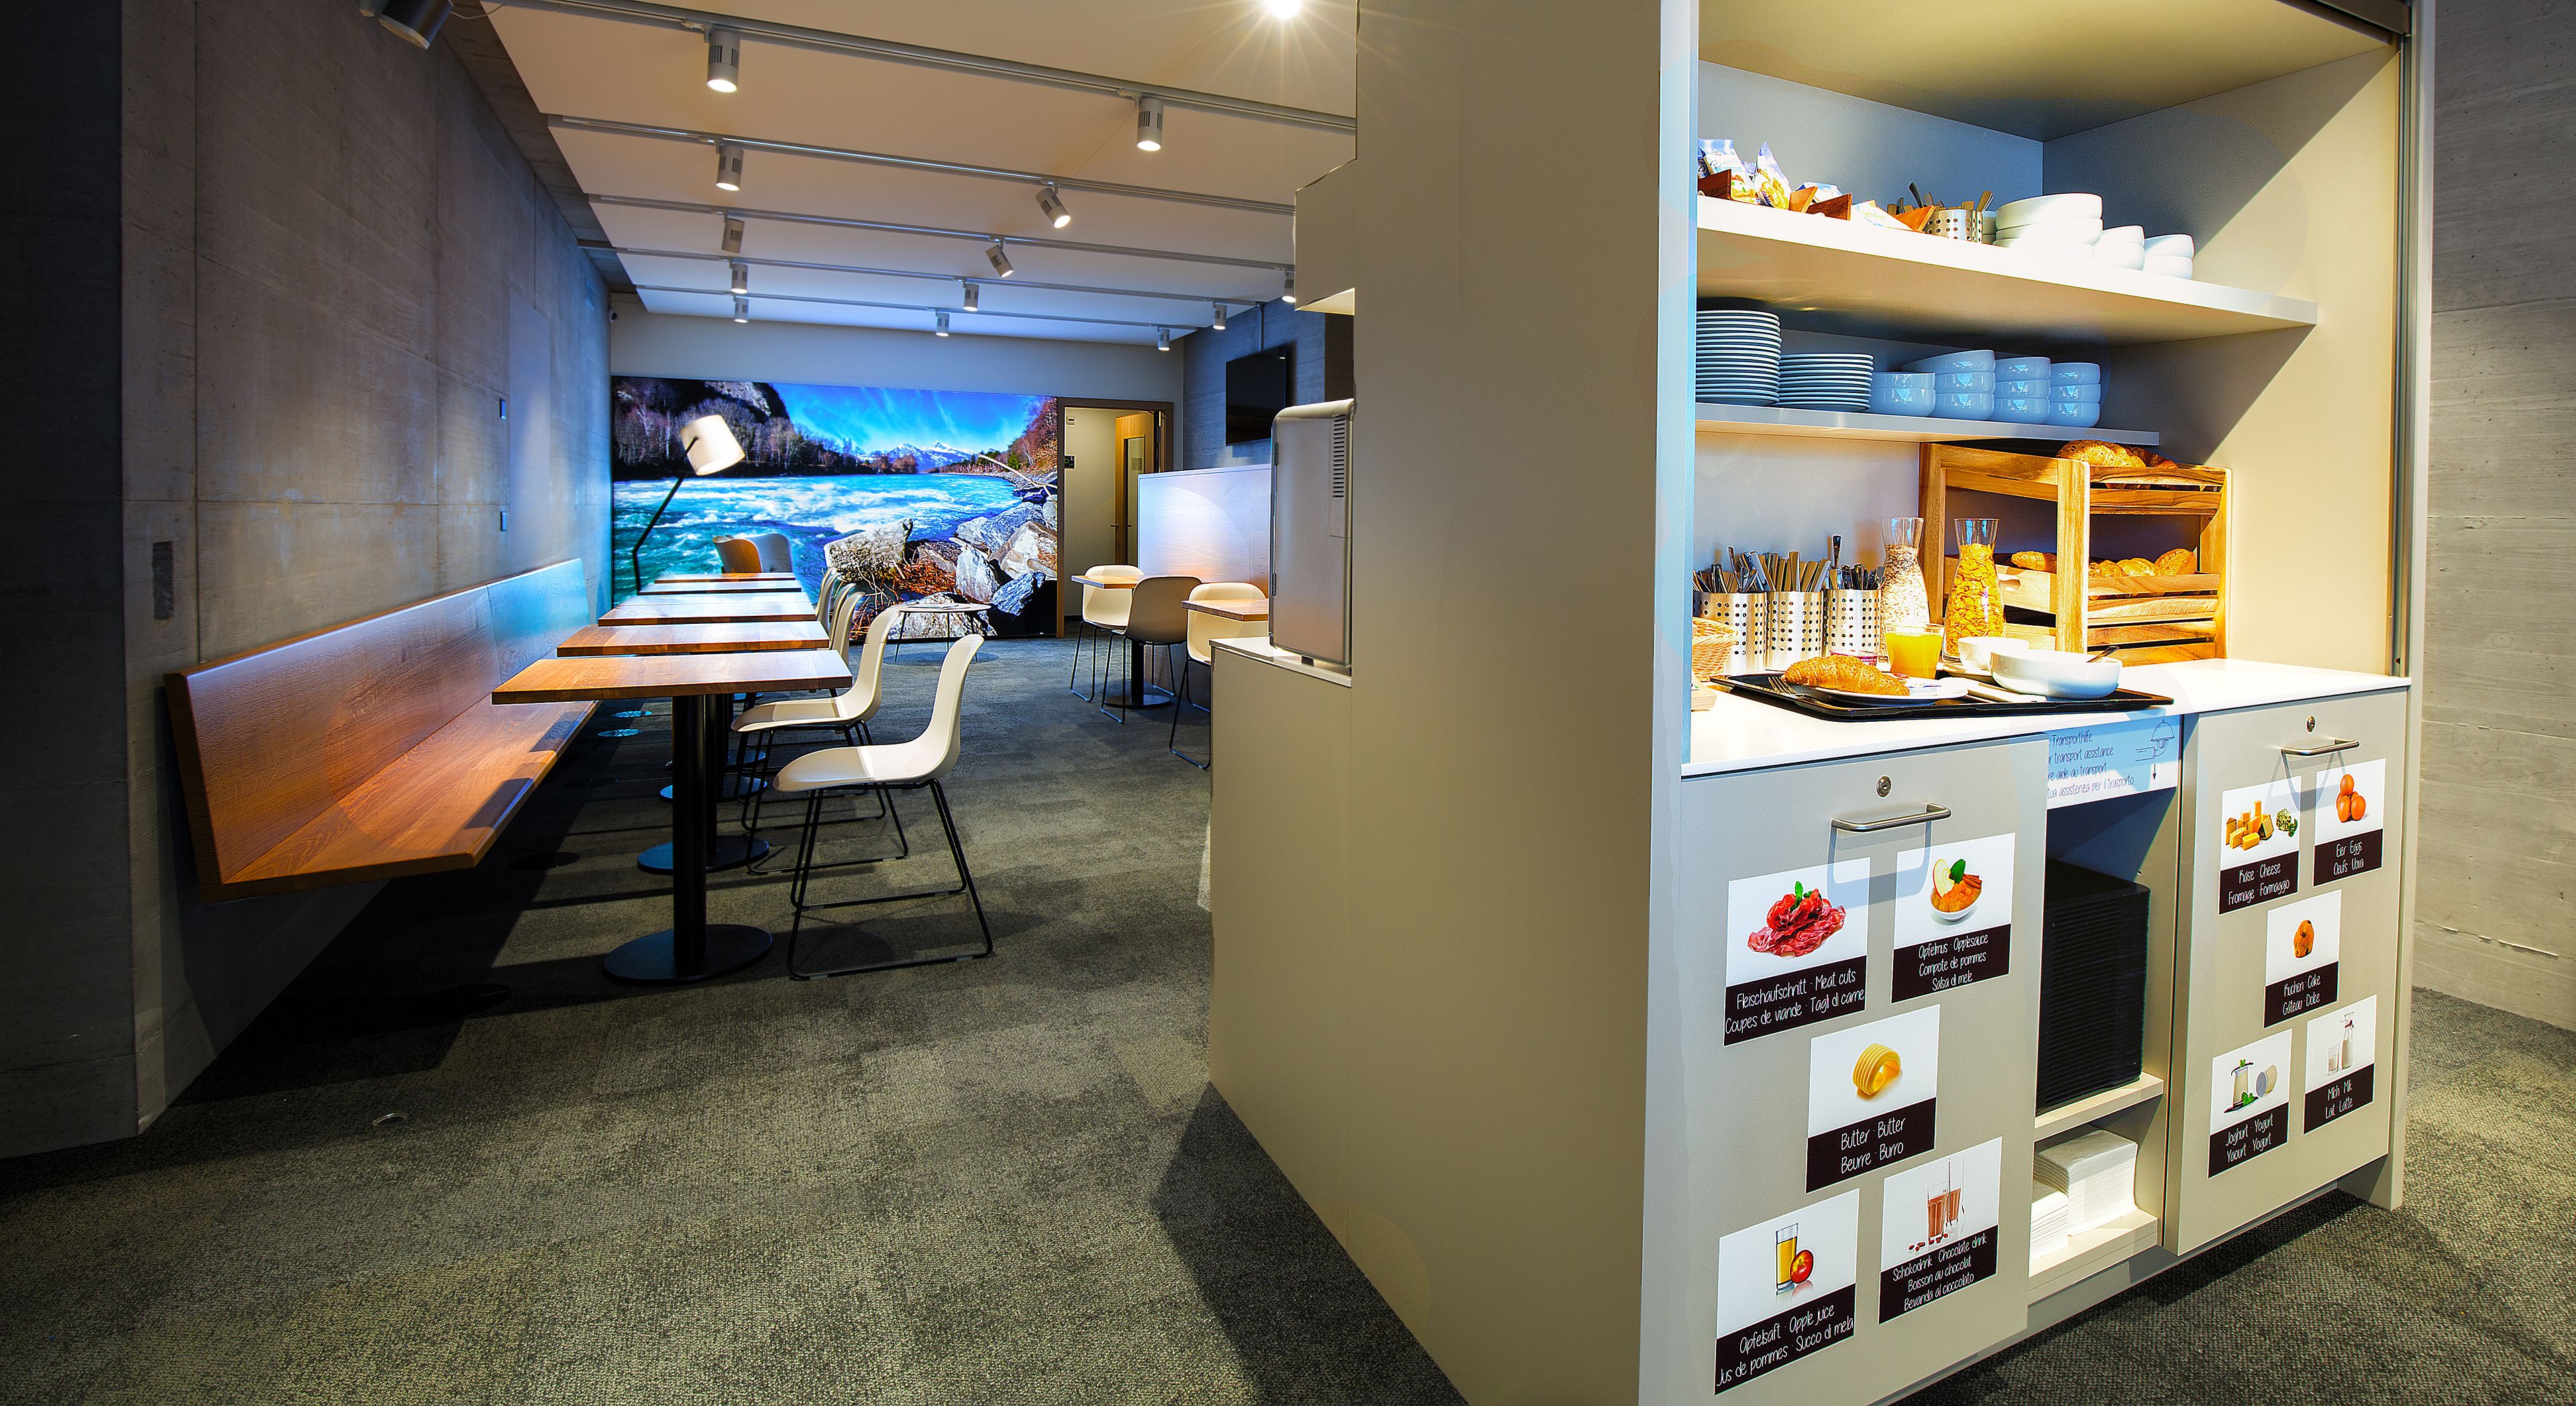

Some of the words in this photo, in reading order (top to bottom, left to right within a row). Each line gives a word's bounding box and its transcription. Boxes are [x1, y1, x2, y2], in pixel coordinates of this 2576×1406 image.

[2054, 749, 2082, 764] transport
[2084, 746, 2113, 759] assistance
[2057, 767, 2069, 780] aide
[2071, 769, 2078, 777] au
[2080, 762, 2106, 777] transport
[2059, 783, 2090, 797] assistenza
[2092, 781, 2100, 794] per
[2108, 774, 2134, 789] trasporto
[2350, 840, 2362, 855] Eggs
[2239, 869, 2254, 883] Käse
[2260, 863, 2281, 878] Cheese
[2334, 859, 2348, 875] Oeufs
[2351, 857, 2364, 870] Uova
[2229, 889, 2255, 906] Fromage
[2260, 877, 2290, 896] Formaggio
[1919, 959, 1948, 977] Compote
[1950, 957, 1958, 969] de
[1960, 953, 1986, 969] pommes
[1737, 979, 1807, 1010] Fleischaufschnitt
[1816, 972, 1836, 991] Meat
[1839, 968, 1856, 984] cuts
[1932, 977, 1949, 991] Salsa
[1951, 974, 1956, 986] di
[1958, 970, 1972, 985] mele
[2284, 981, 2304, 997] Kuchen
[2308, 974, 2320, 989] Cake
[1725, 1016, 1758, 1034] Coupes
[1761, 1010, 1772, 1024] de
[1775, 1002, 1802, 1022] viande
[1811, 994, 1829, 1013] Tagli
[1832, 993, 1838, 1006] di
[1841, 989, 1864, 1005] carne
[2283, 999, 2302, 1015] Gâteau
[2306, 991, 2320, 1006] Dolce
[2339, 1097, 2353, 1112] Latte
[1841, 1129, 1870, 1150] Butter
[1878, 1118, 1905, 1138] Butter
[2226, 1124, 2249, 1146] Joghurt
[2255, 1114, 2273, 1133] Yogurt
[1841, 1152, 1872, 1174] Beurre
[1880, 1142, 1903, 1160] Burro
[2227, 1143, 2246, 1162] Yaourt
[2253, 1132, 2271, 1151] Yogurt
[1893, 1255, 1932, 1281] Schokodrink
[1939, 1240, 1970, 1262] Chocolate
[1972, 1233, 1986, 1248] drink
[1909, 1274, 1933, 1292] Boisson
[1935, 1269, 1943, 1281] au
[1945, 1255, 1971, 1276] chocolat
[1904, 1290, 1933, 1311] Bevanda
[1935, 1284, 1941, 1297] al
[1943, 1272, 1974, 1294] cioccolato
[1790, 1311, 1814, 1334] Apple
[1815, 1305, 1834, 1325] juice
[1717, 1369, 1732, 1386] Jus
[1735, 1362, 1747, 1377] de
[1750, 1346, 1788, 1374] pommes
[1796, 1332, 1821, 1351] Succo
[1825, 1324, 1831, 1339] di
[1835, 1315, 1853, 1336] mela
